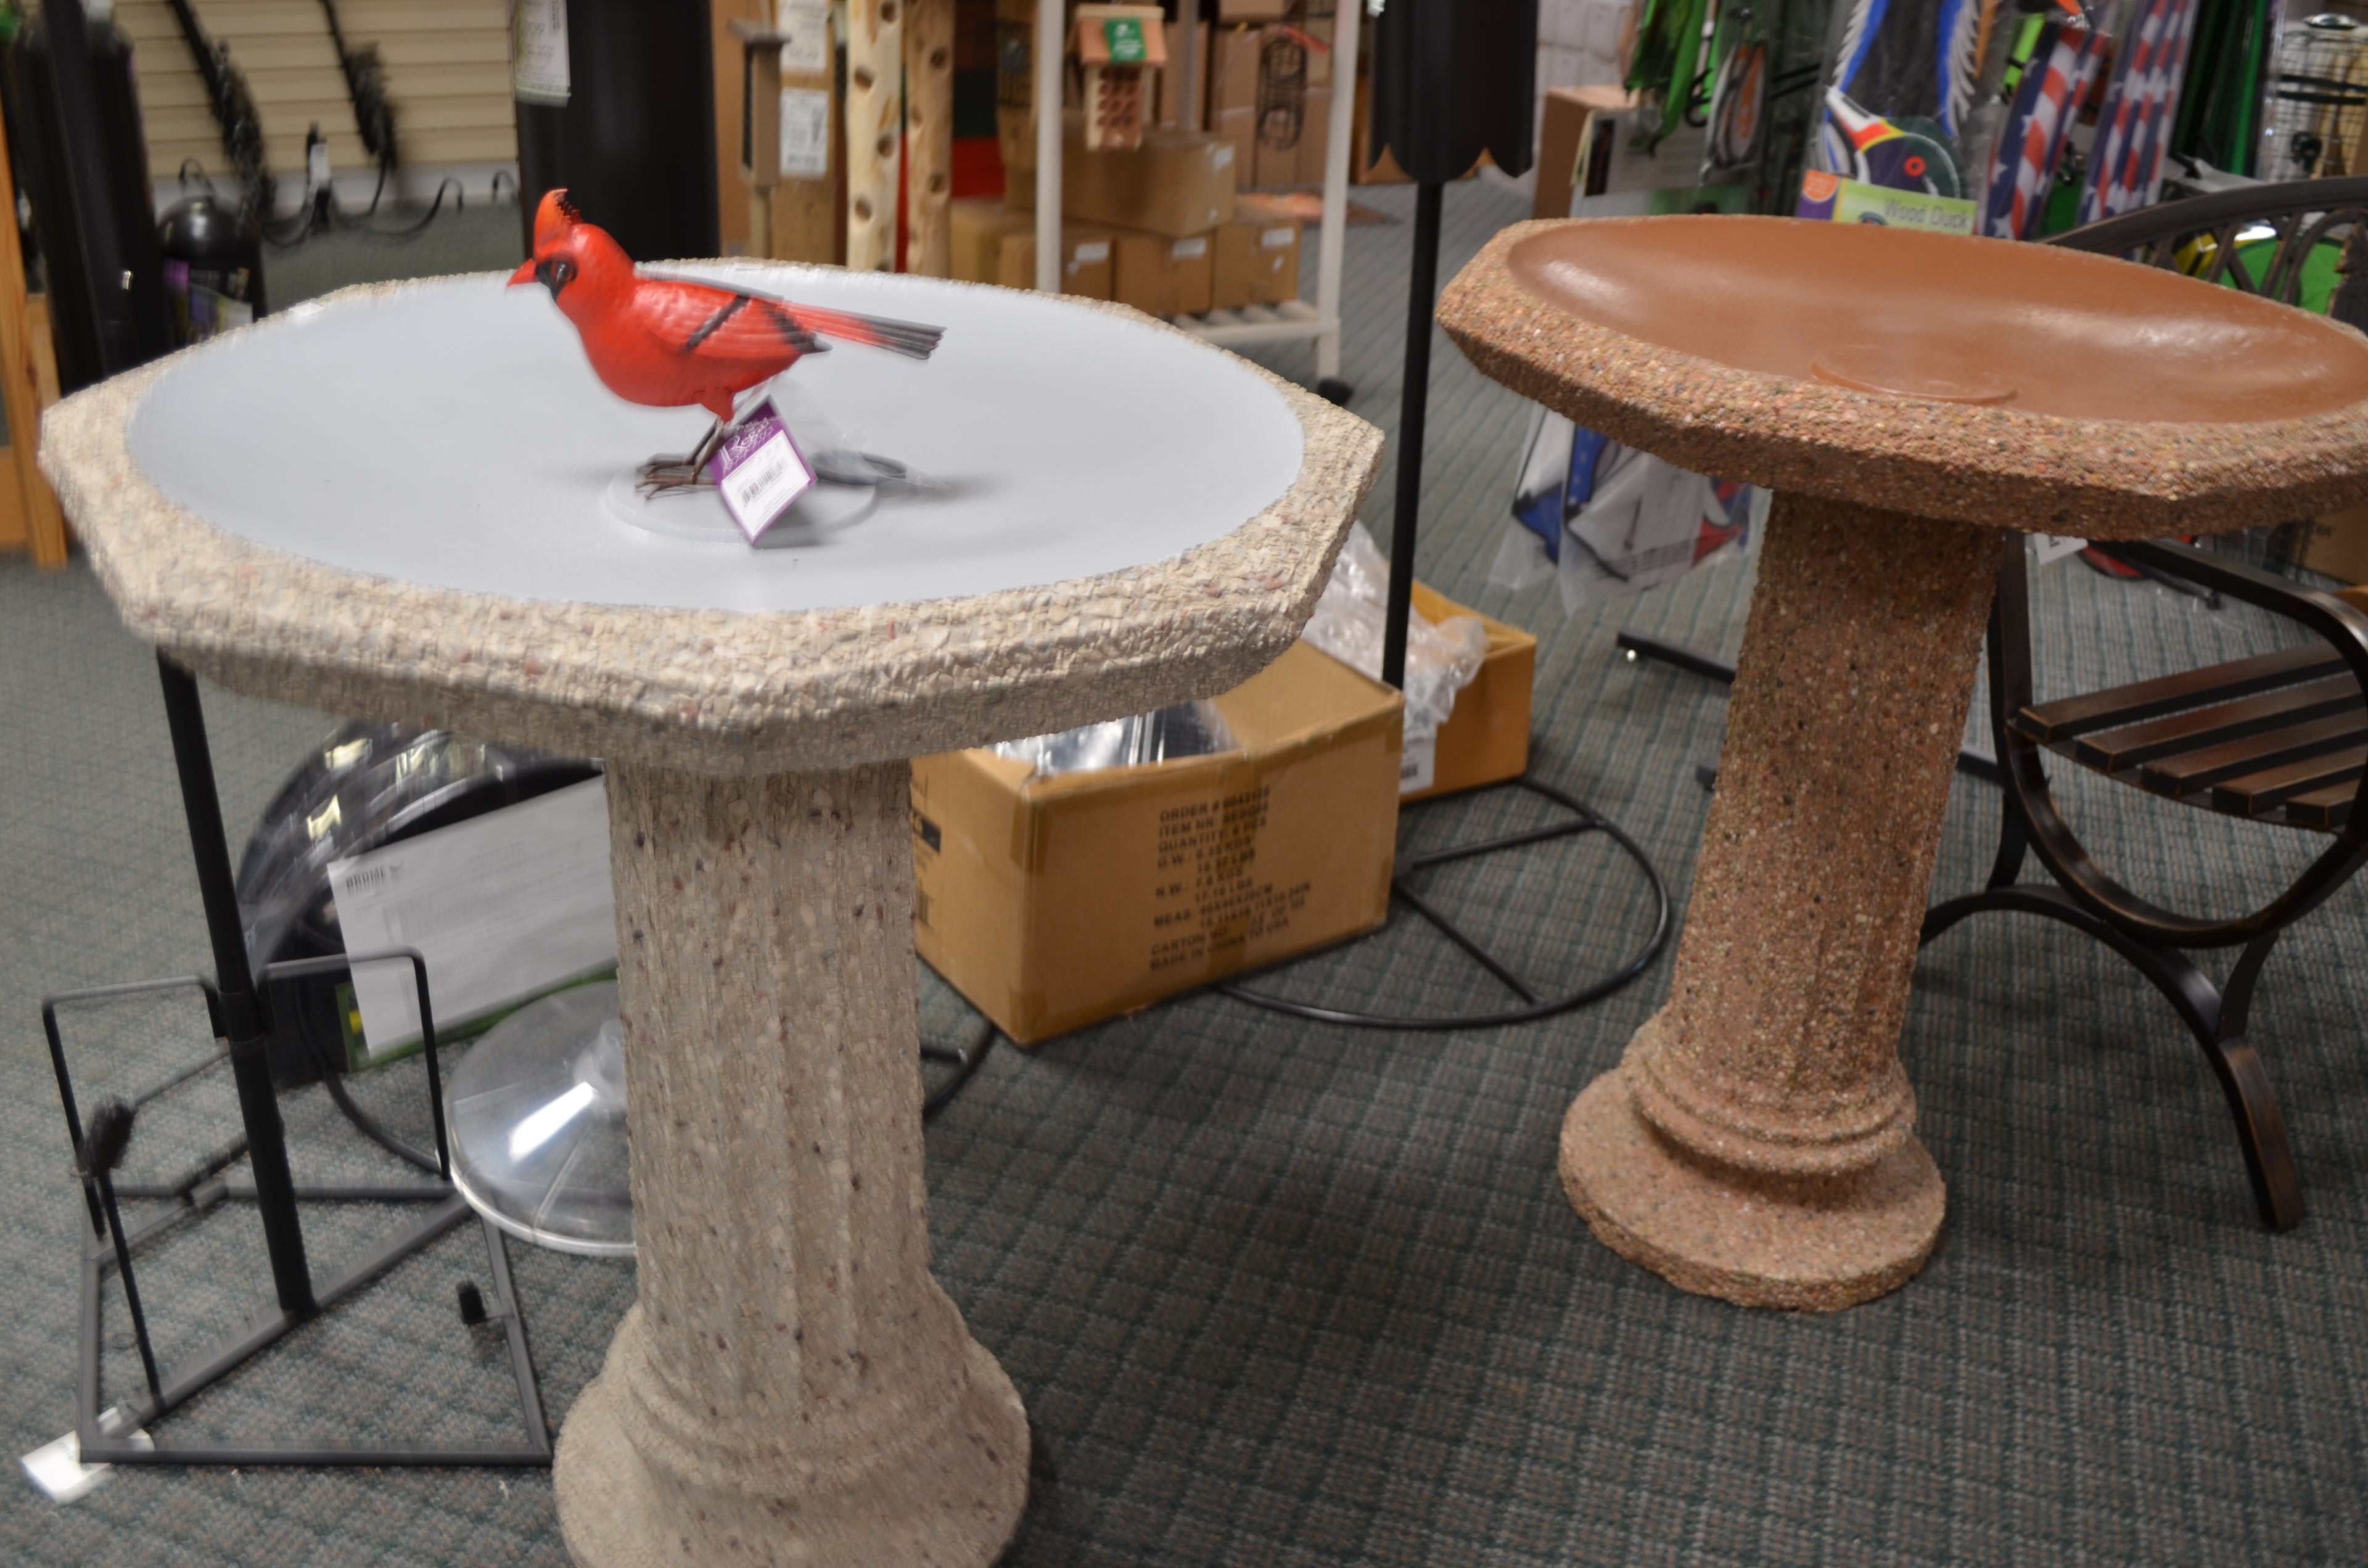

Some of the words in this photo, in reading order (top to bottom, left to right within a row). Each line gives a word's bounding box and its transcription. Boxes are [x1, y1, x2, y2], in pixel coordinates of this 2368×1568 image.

[1885, 198, 1926, 223] Wood
[1930, 205, 1968, 229] Duck
[1160, 803, 1208, 822] ORDER
[1159, 822, 1191, 839] ITEM
[1151, 932, 1205, 956] CARTON
[1149, 951, 1186, 971] MADE
